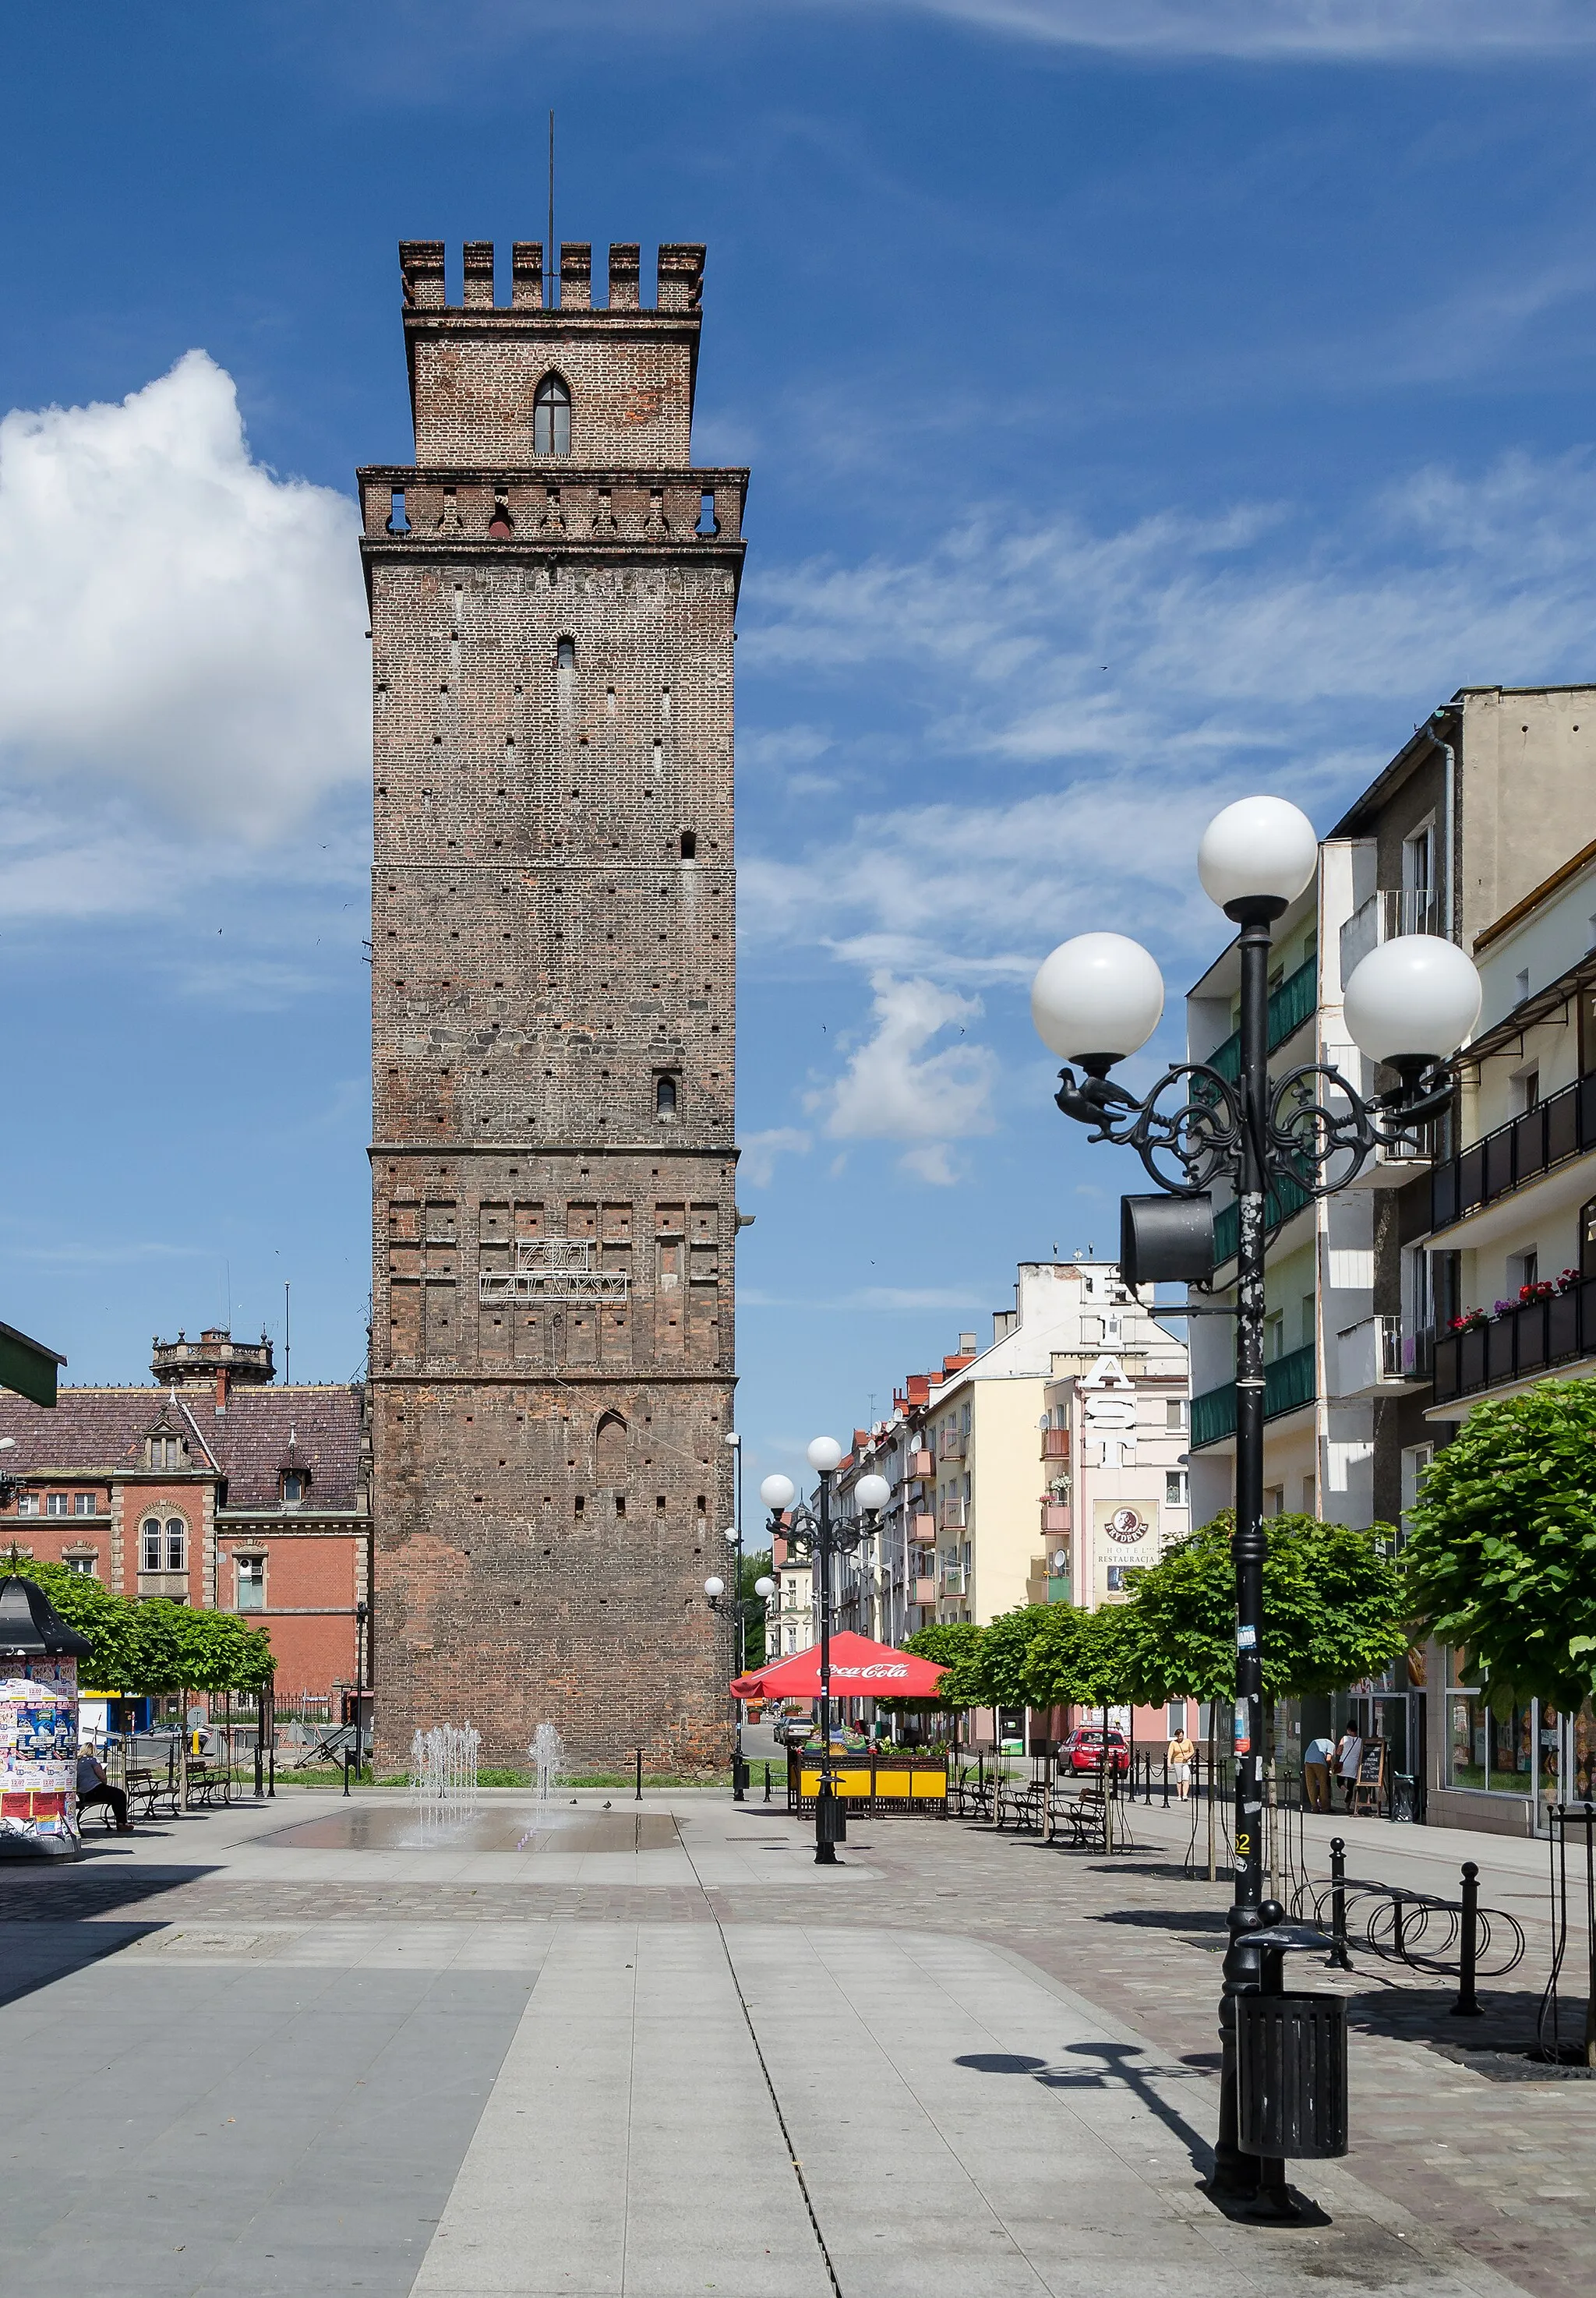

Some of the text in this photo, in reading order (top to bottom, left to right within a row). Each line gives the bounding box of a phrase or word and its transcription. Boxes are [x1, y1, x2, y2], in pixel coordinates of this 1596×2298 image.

[521, 1241, 586, 1270] 790
[483, 1273, 545, 1299] LAT
[1105, 1523, 1148, 1543] FRYDERYK
